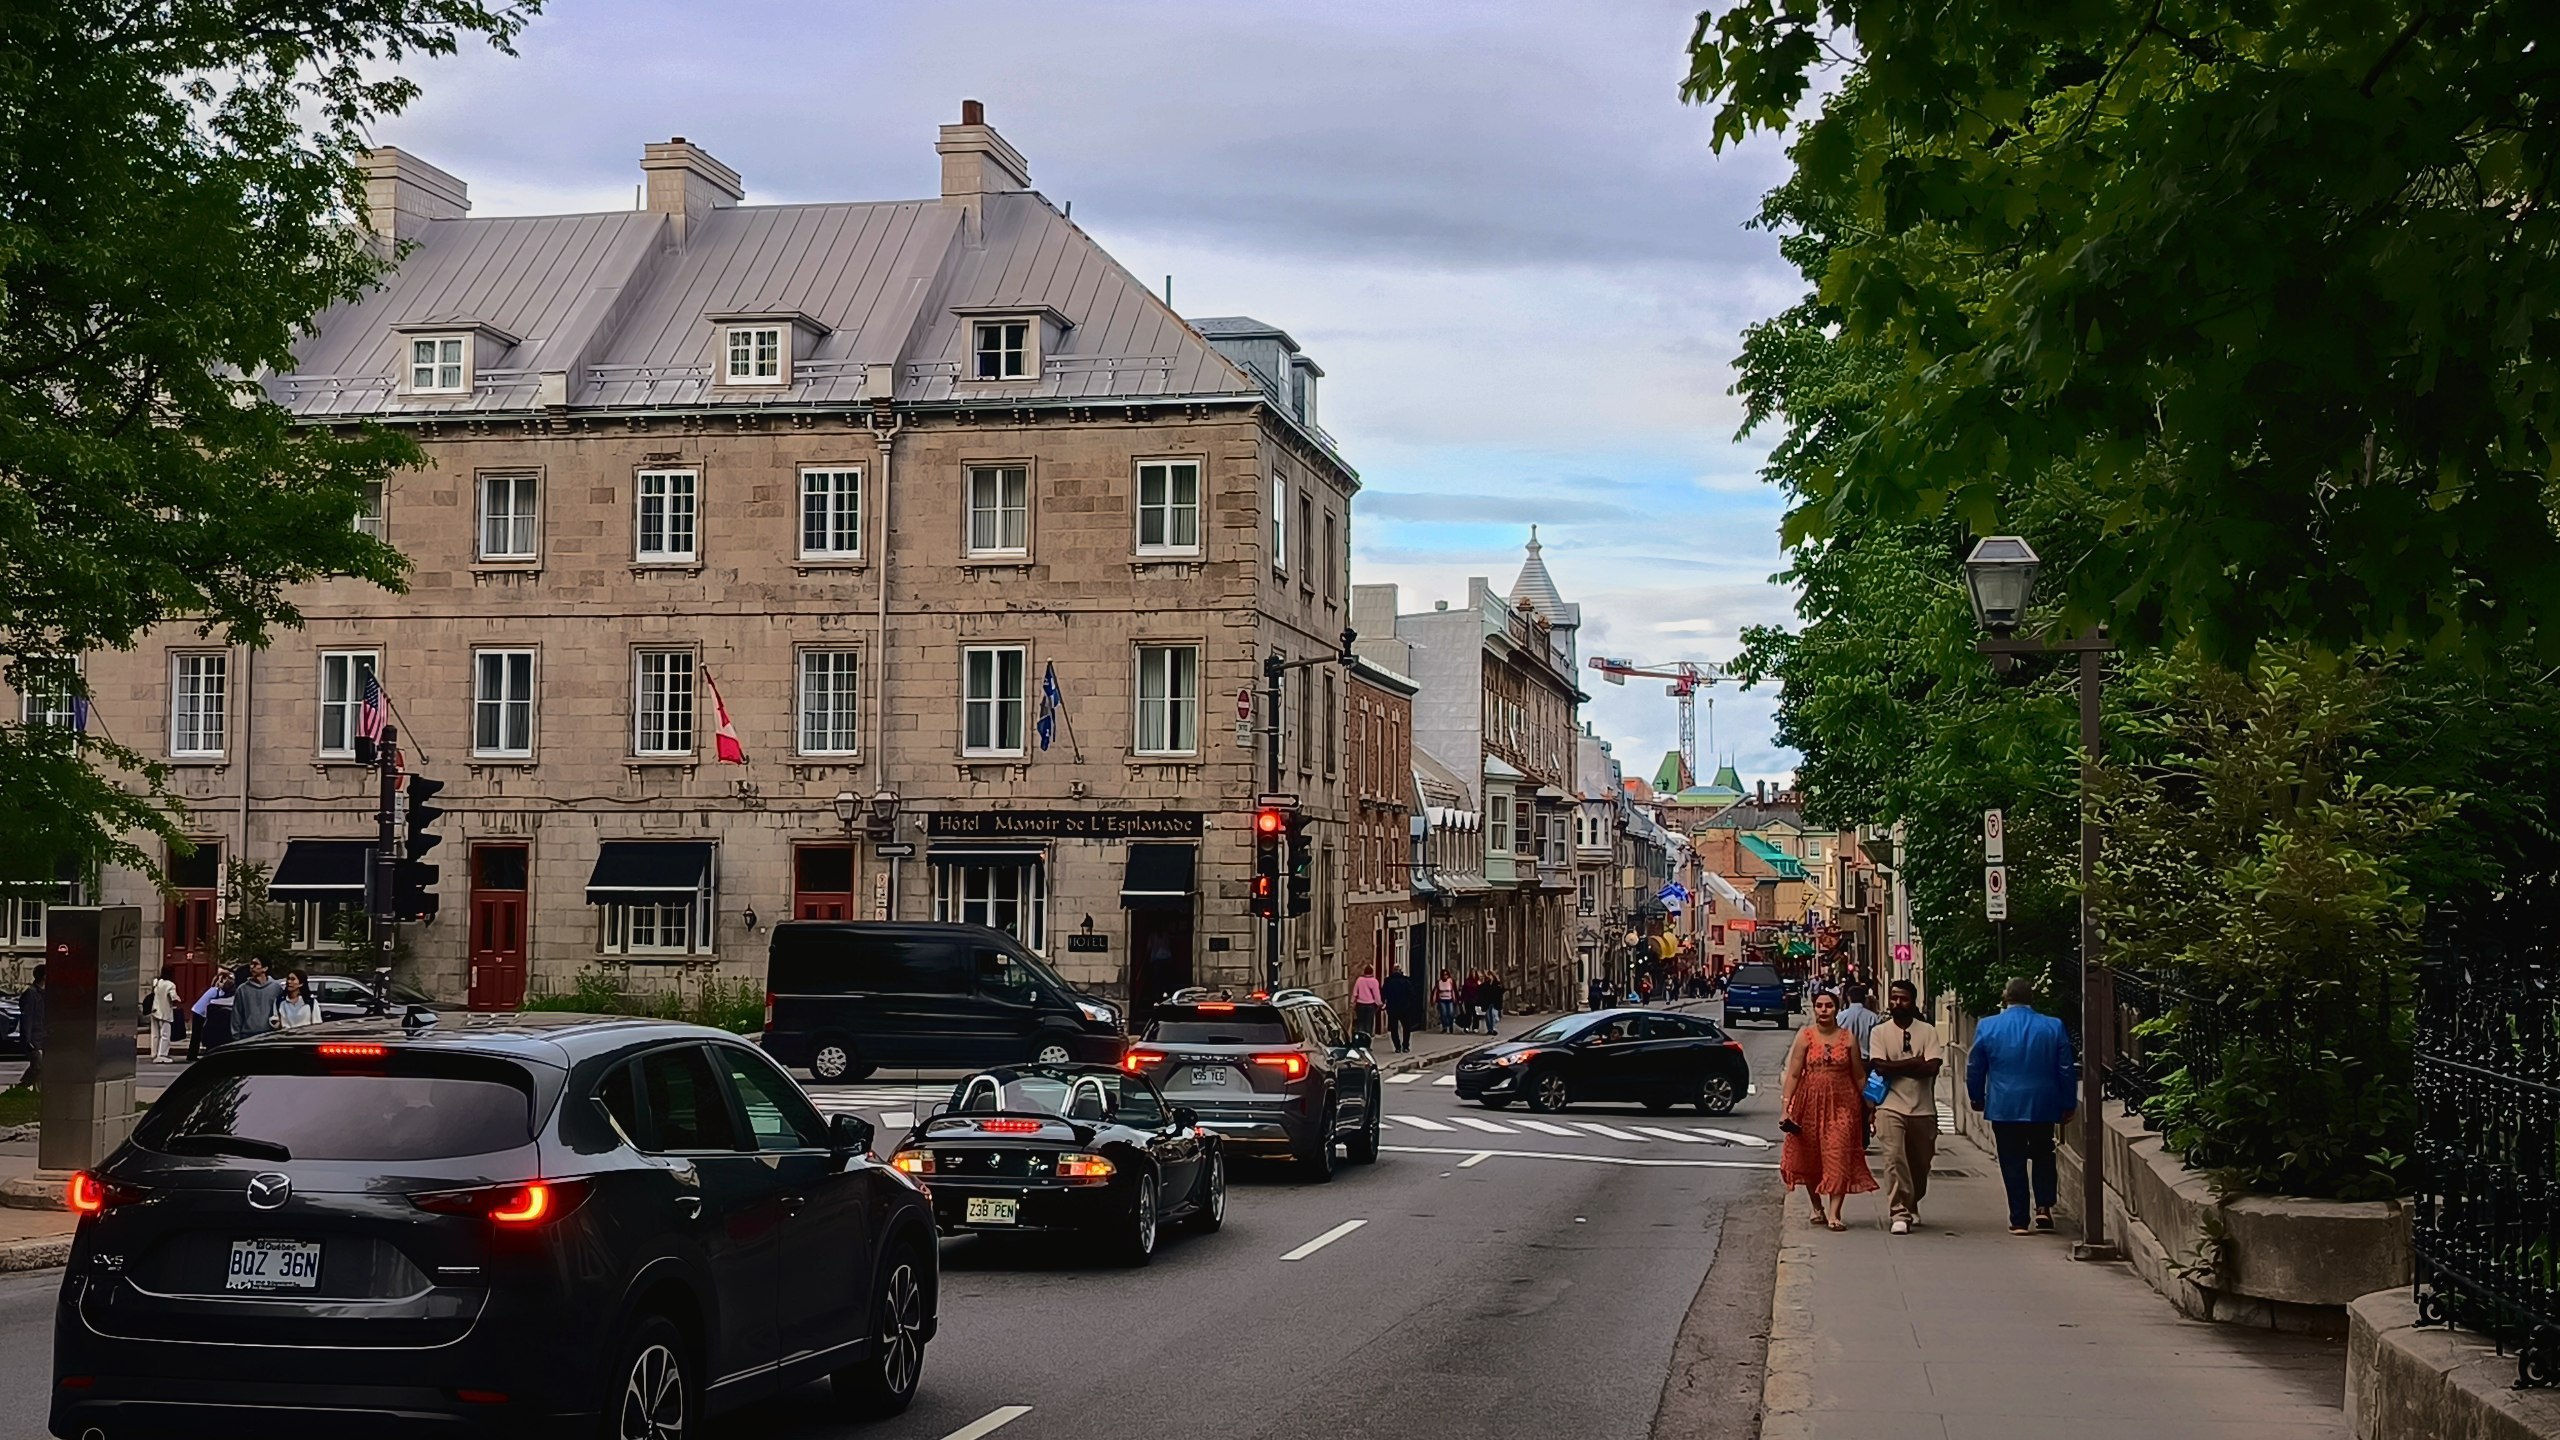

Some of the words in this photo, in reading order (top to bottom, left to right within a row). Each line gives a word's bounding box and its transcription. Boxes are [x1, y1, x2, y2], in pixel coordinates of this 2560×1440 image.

[939, 815, 979, 831] Hôtel
[995, 816, 1060, 831] Manoir
[1066, 818, 1085, 831] de
[1091, 815, 1193, 835] L'Esplanade
[994, 1204, 1014, 1218] PEN
[265, 1242, 297, 1251] Québec
[230, 1249, 269, 1276] BQZ
[279, 1251, 318, 1278] 36N
